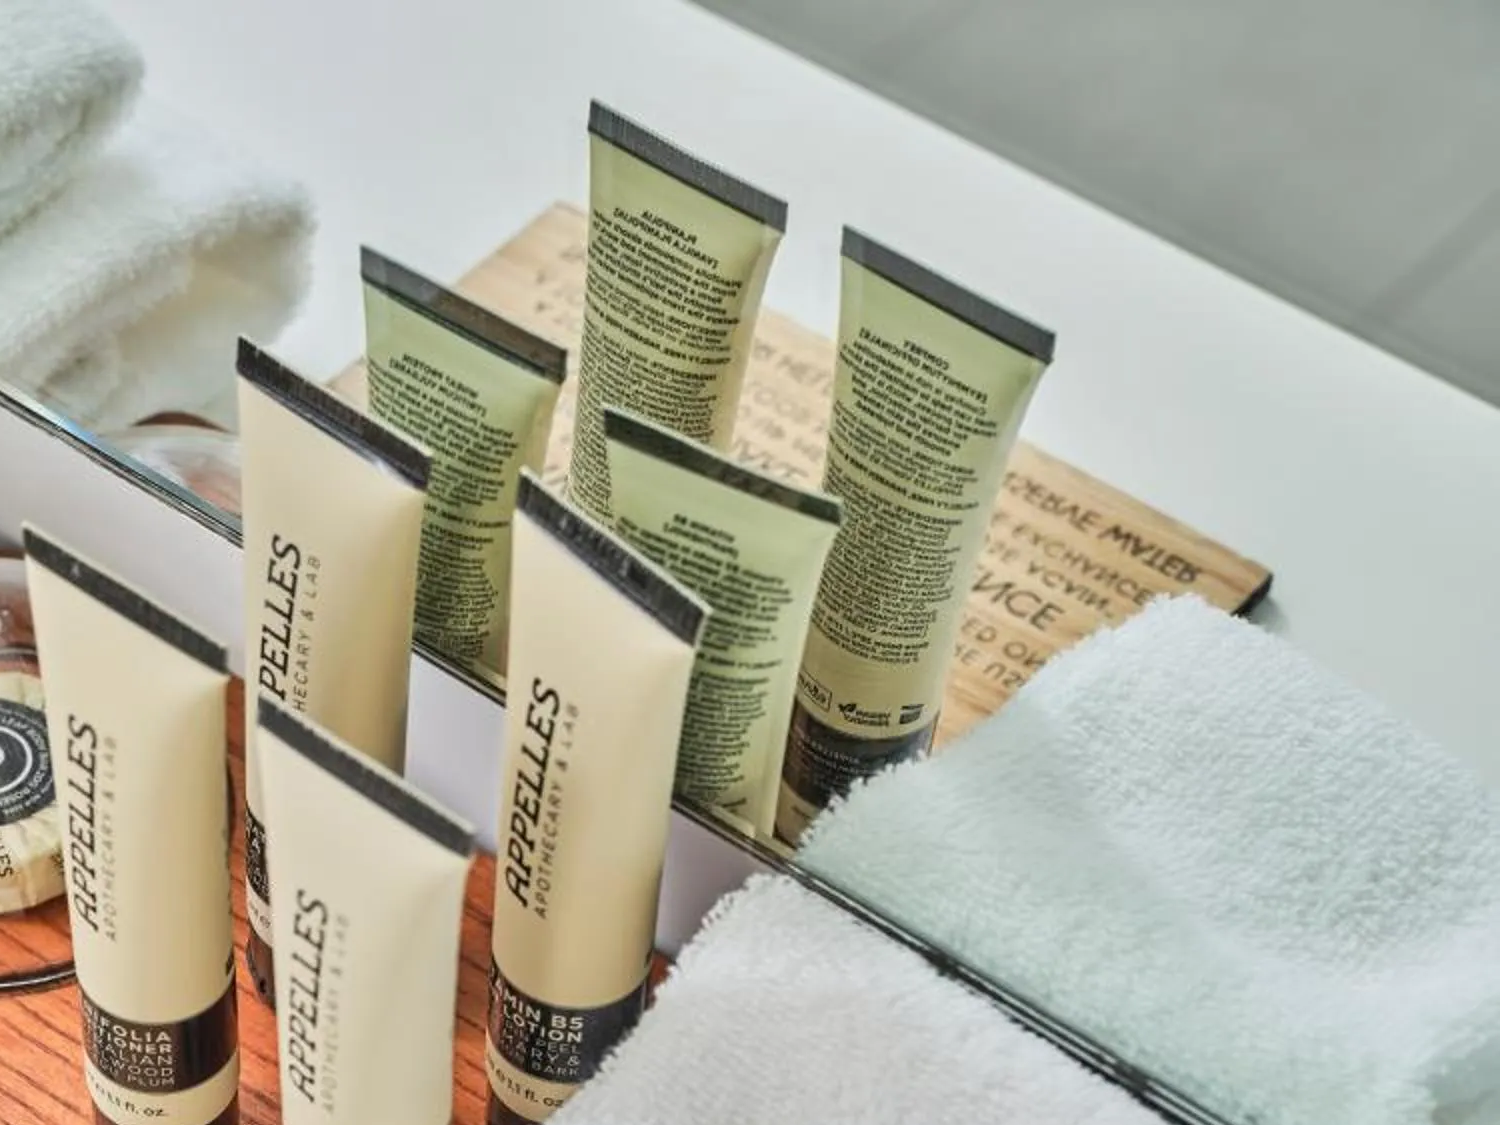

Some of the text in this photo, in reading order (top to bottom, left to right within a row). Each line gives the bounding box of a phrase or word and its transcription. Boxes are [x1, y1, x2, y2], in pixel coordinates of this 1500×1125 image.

[68, 713, 99, 932] APPELLES
[505, 677, 561, 909] APPELLES
[533, 780, 563, 920] APOTHECARY
[289, 889, 329, 1103] APPELLES
